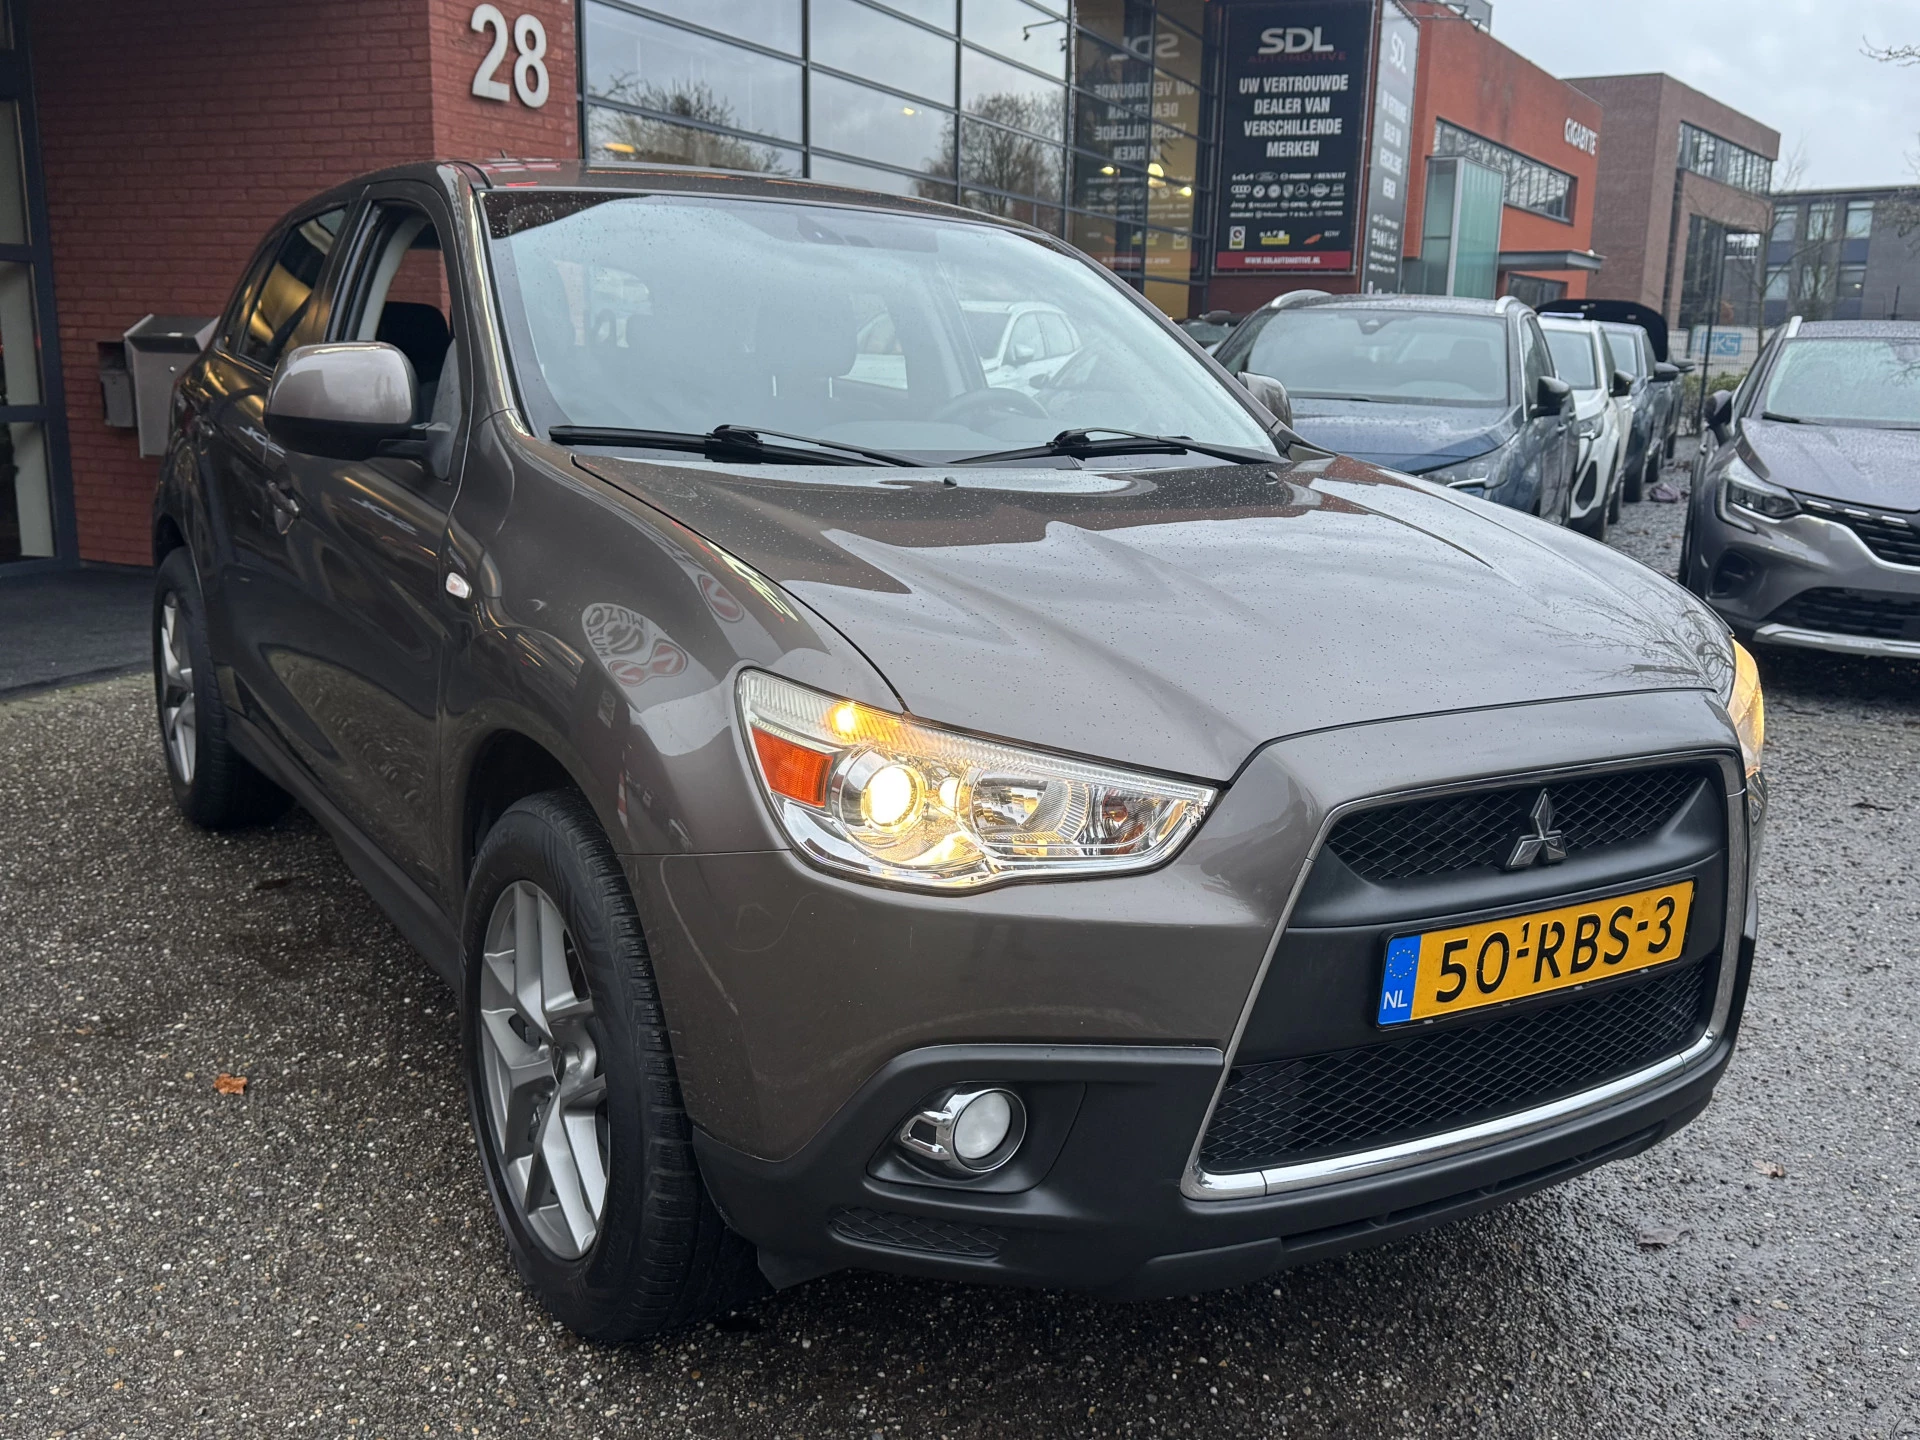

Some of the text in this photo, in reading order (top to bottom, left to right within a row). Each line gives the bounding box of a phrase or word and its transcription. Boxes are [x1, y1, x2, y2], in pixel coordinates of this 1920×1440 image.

[1258, 26, 1334, 54] SDL
[471, 3, 550, 108] 28
[1239, 74, 1348, 93] UW VERTROUWDE
[1254, 96, 1330, 115] DEALER VAN
[1244, 117, 1342, 136] VERSCHILLENDE
[1266, 140, 1319, 157] MERKEN
[1436, 896, 1675, 1003] 50-RBS-3
[1383, 990, 1408, 1010] NL
